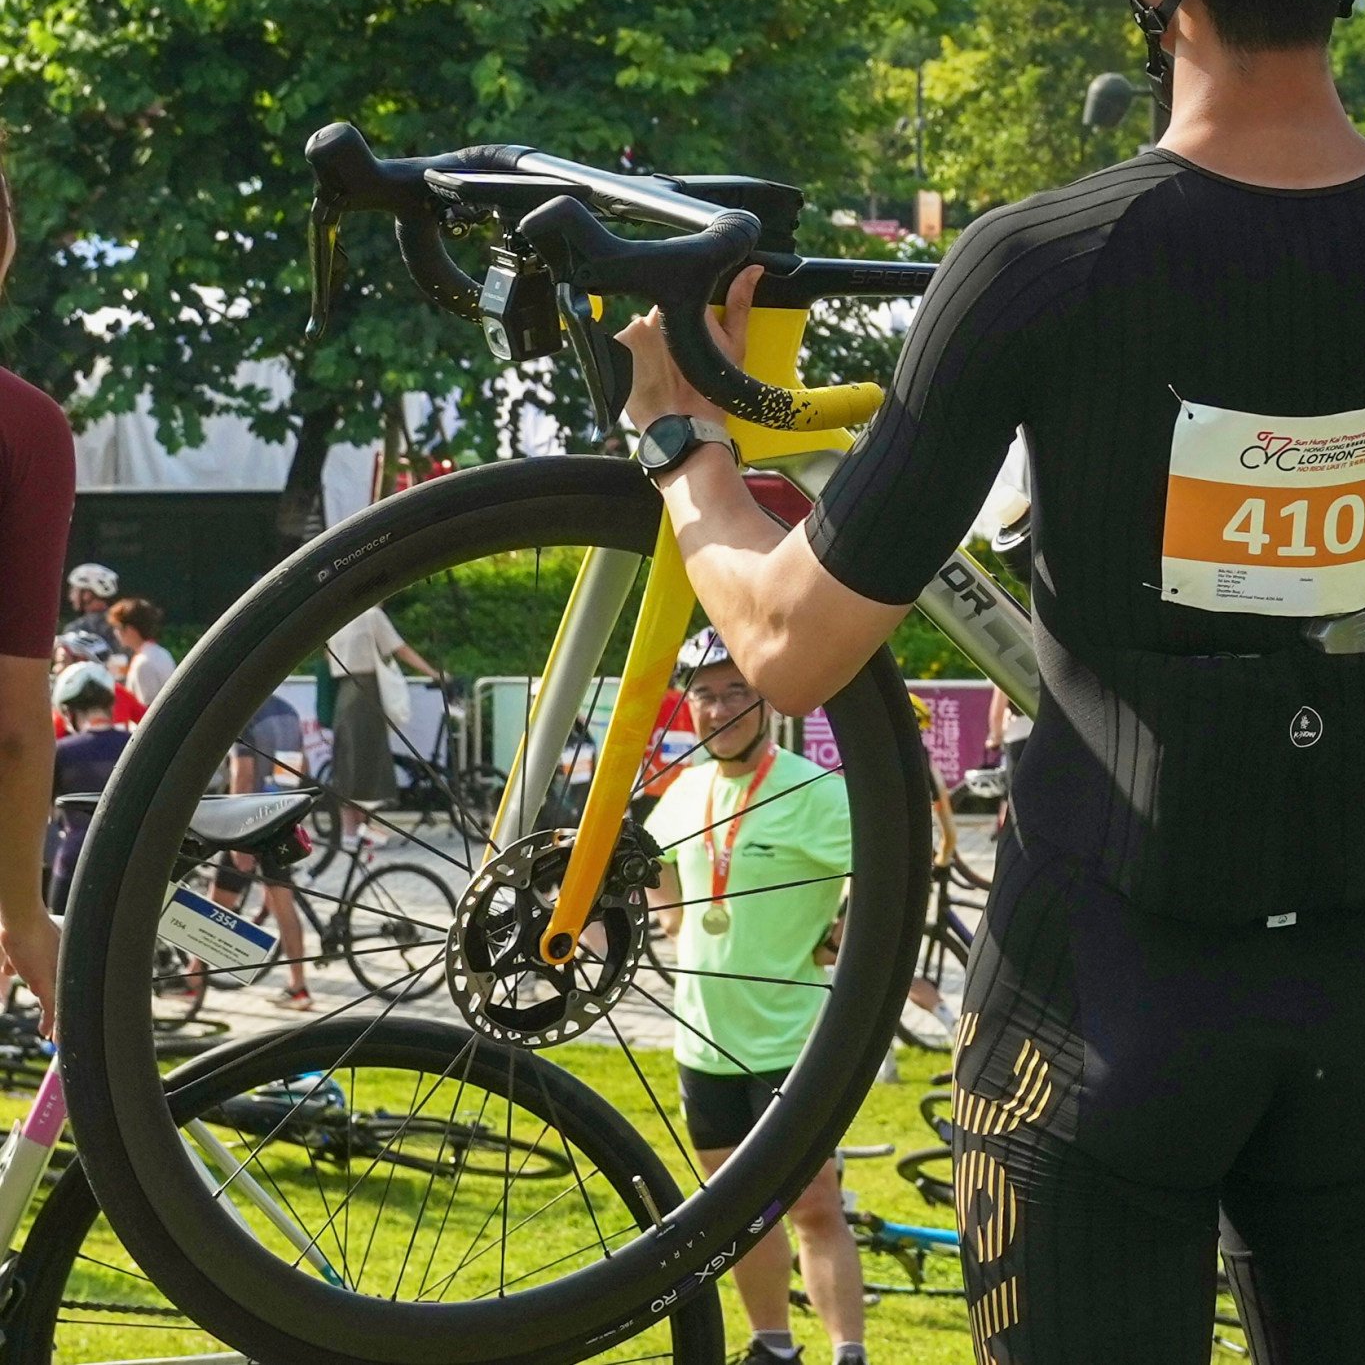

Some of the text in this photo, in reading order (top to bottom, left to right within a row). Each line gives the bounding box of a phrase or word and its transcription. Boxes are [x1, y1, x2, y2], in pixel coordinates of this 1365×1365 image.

[1308, 438, 1328, 447] Hung
[1325, 444, 1345, 452] KONG
[333, 532, 392, 571] Panaracer
[170, 917, 187, 930] 7354
[209, 909, 238, 929] 7354
[660, 1230, 706, 1269] LARK
